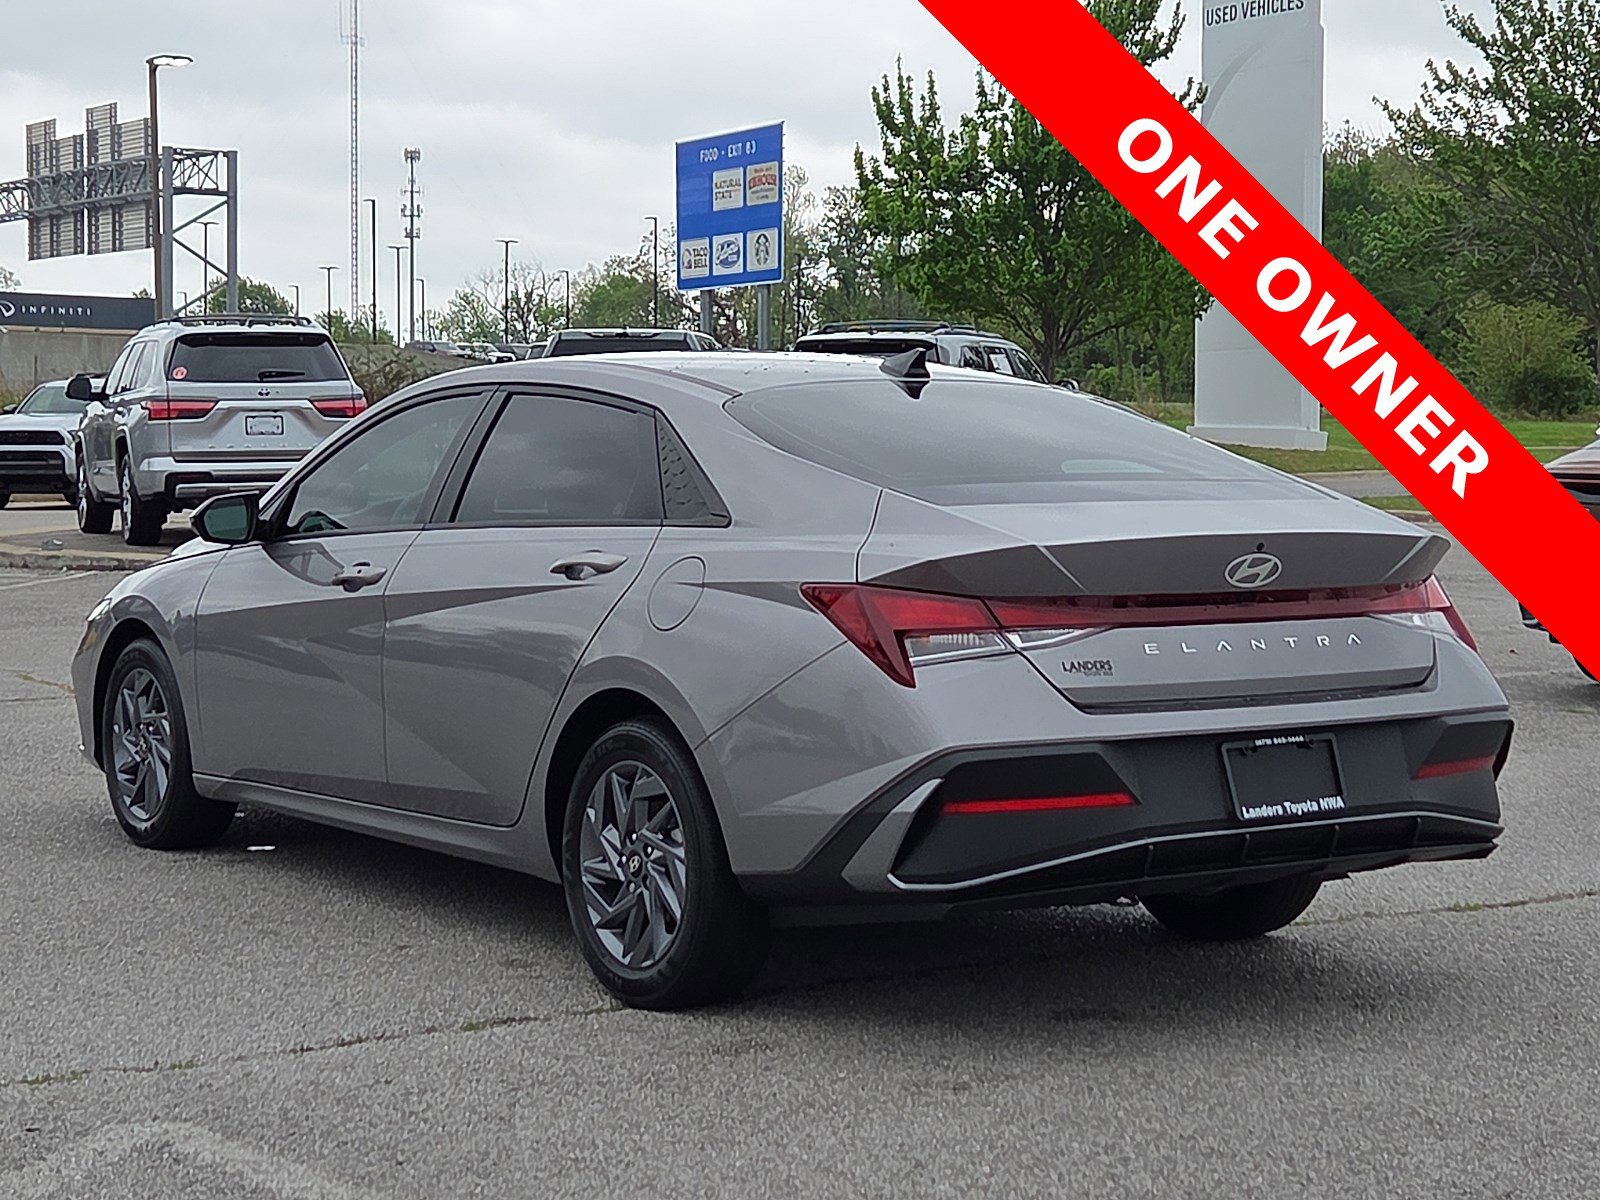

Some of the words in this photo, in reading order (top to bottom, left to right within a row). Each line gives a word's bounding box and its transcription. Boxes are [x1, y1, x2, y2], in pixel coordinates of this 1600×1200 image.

[1206, 5, 1237, 26] USED
[1241, 0, 1304, 19] VEHICLES
[700, 147, 718, 163] FOOD
[727, 142, 742, 158] EXIT
[693, 247, 708, 258] TACO
[693, 258, 708, 269] BELL
[21, 305, 92, 316] INFINITI
[1144, 634, 1361, 655] ELANTRA
[1062, 660, 1112, 673] LANDERS
[1242, 804, 1283, 819] Landers
[1283, 800, 1318, 815] Toyota
[1319, 796, 1345, 810] NWA
